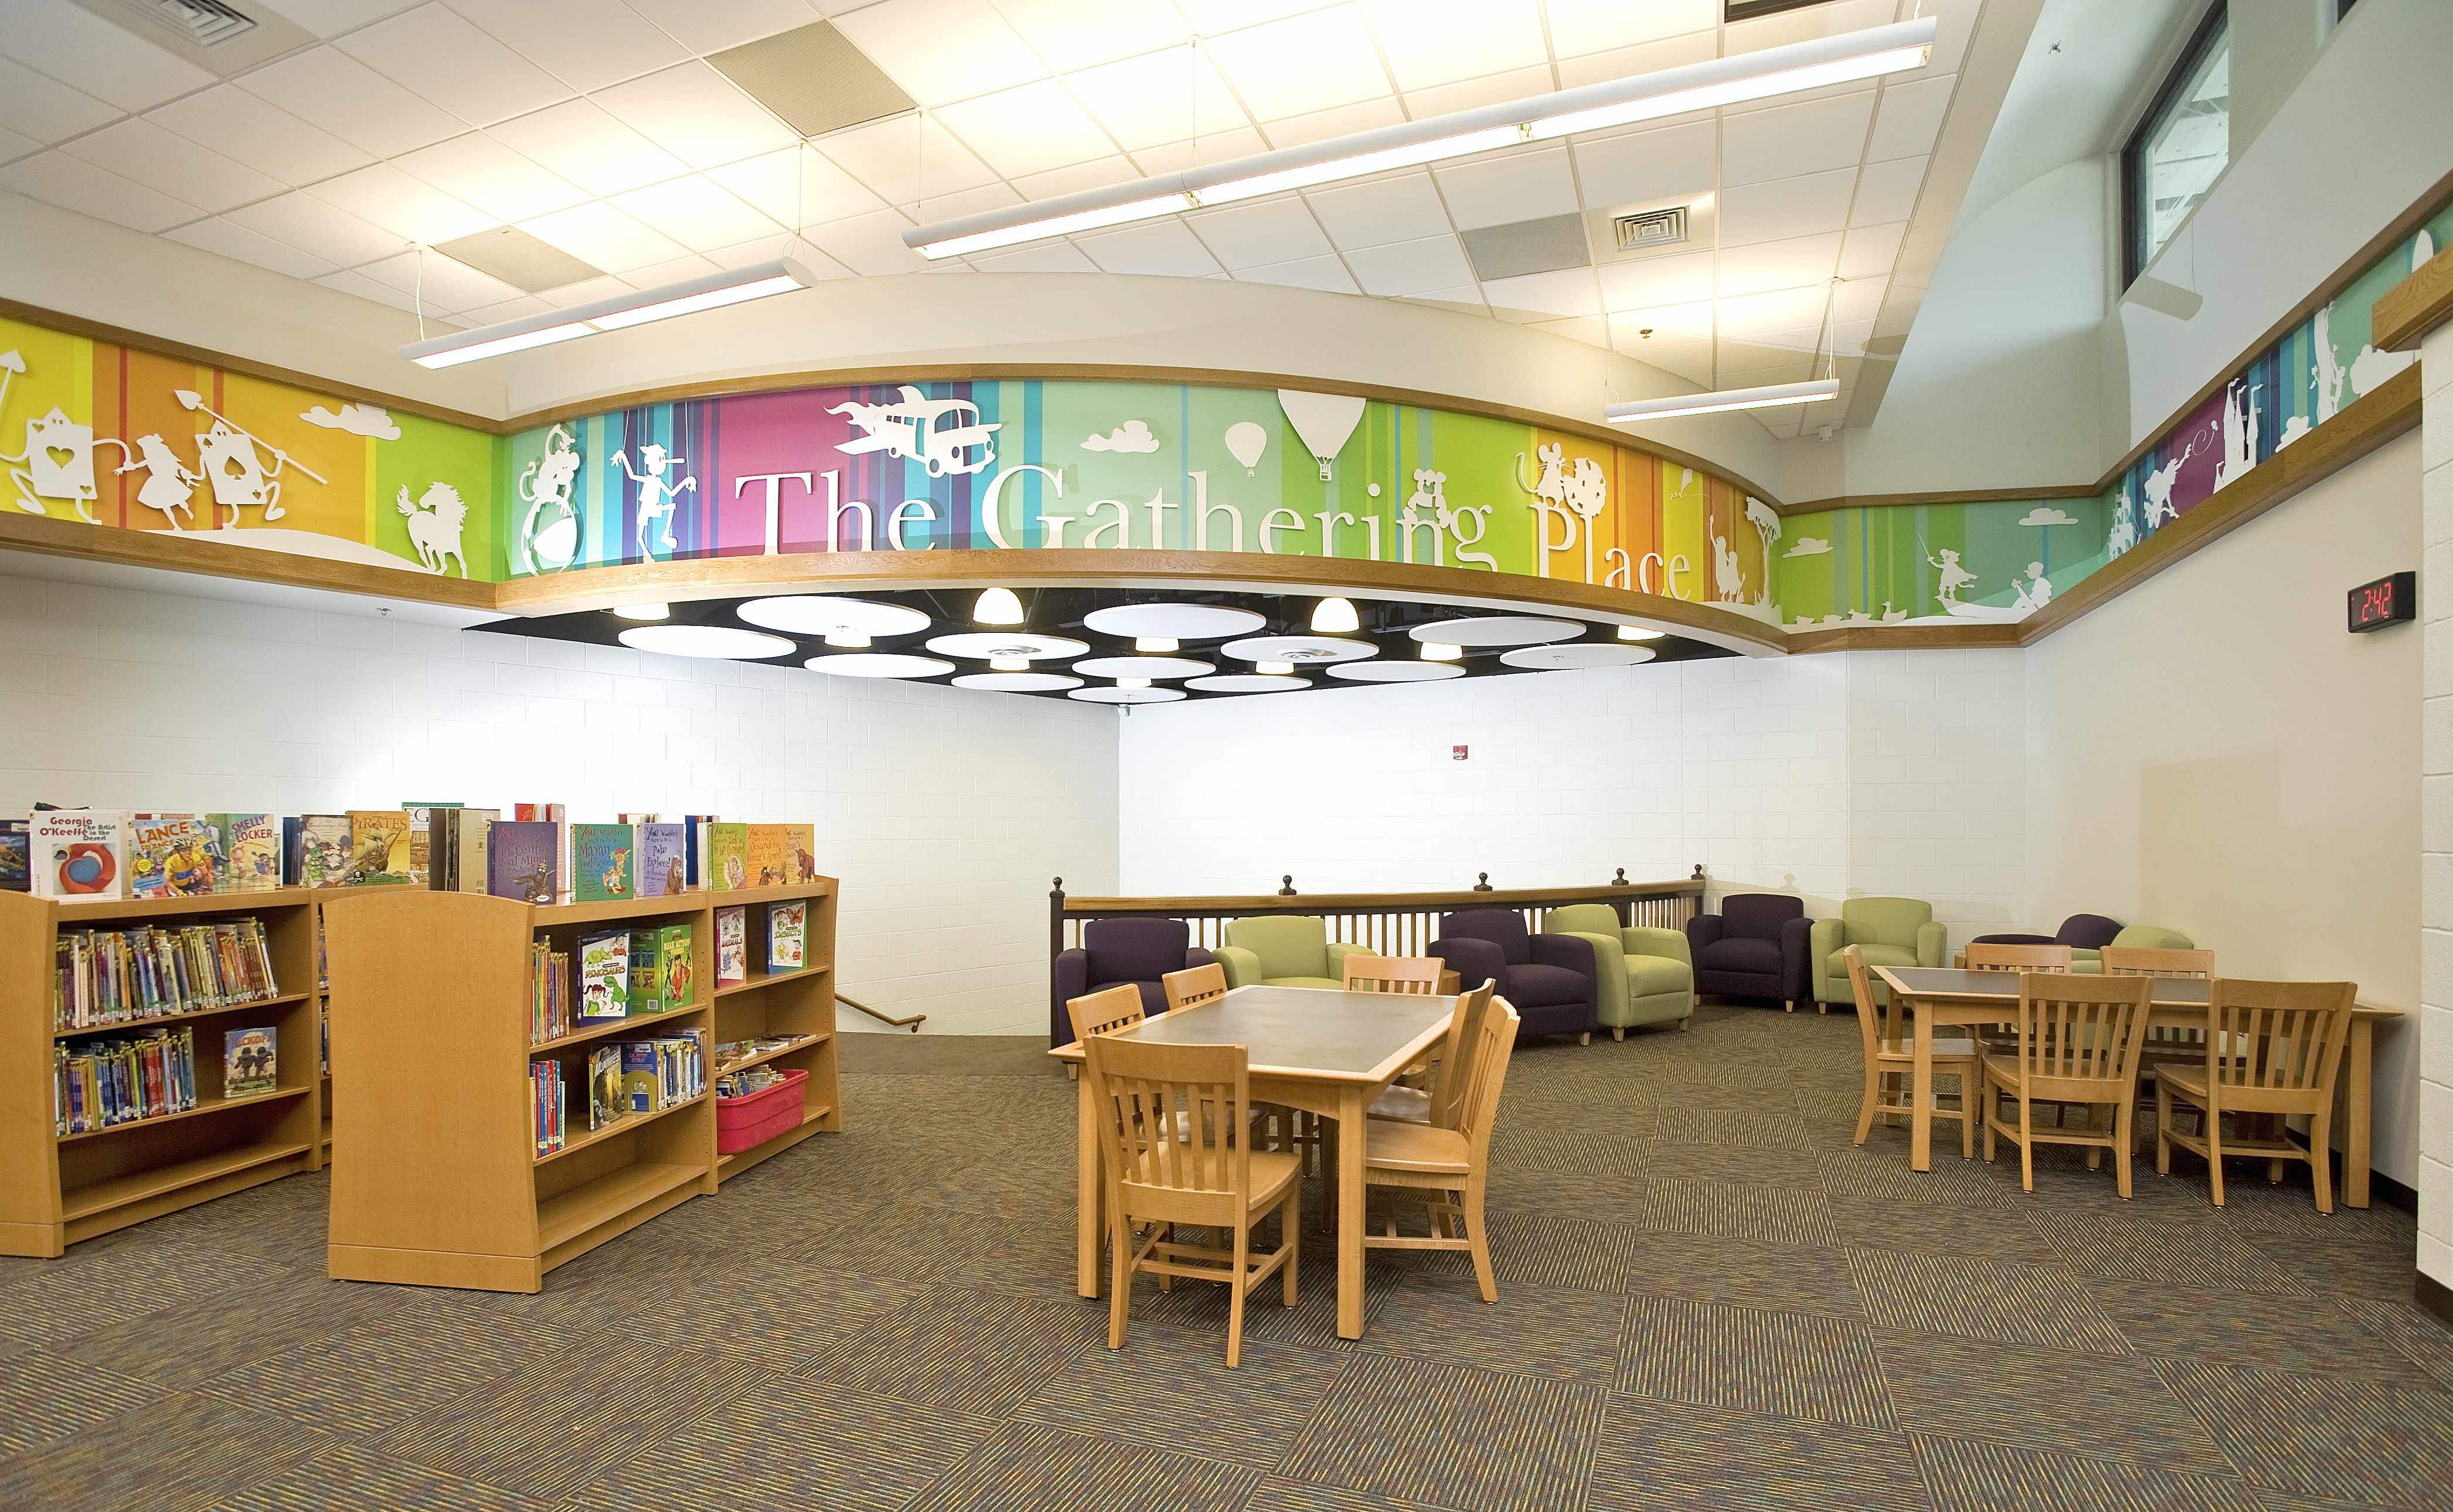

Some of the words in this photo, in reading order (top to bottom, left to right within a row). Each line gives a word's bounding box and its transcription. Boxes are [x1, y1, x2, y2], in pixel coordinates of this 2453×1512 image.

[735, 469, 936, 556] The
[982, 465, 1498, 572] Gathering
[1529, 502, 1690, 600] Place
[2362, 582, 2391, 622] 2:42
[50, 817, 93, 827] Georgia
[232, 815, 265, 833] SMELLY
[40, 827, 88, 836] O'Keeffe
[135, 821, 189, 844] LANCE
[236, 829, 273, 843] LOCKER
[646, 827, 659, 840] You
[141, 839, 175, 852] FRANCE
[579, 843, 610, 858] Mayan
[652, 844, 667, 856] Polar
[586, 966, 625, 979] DINOSAURS
